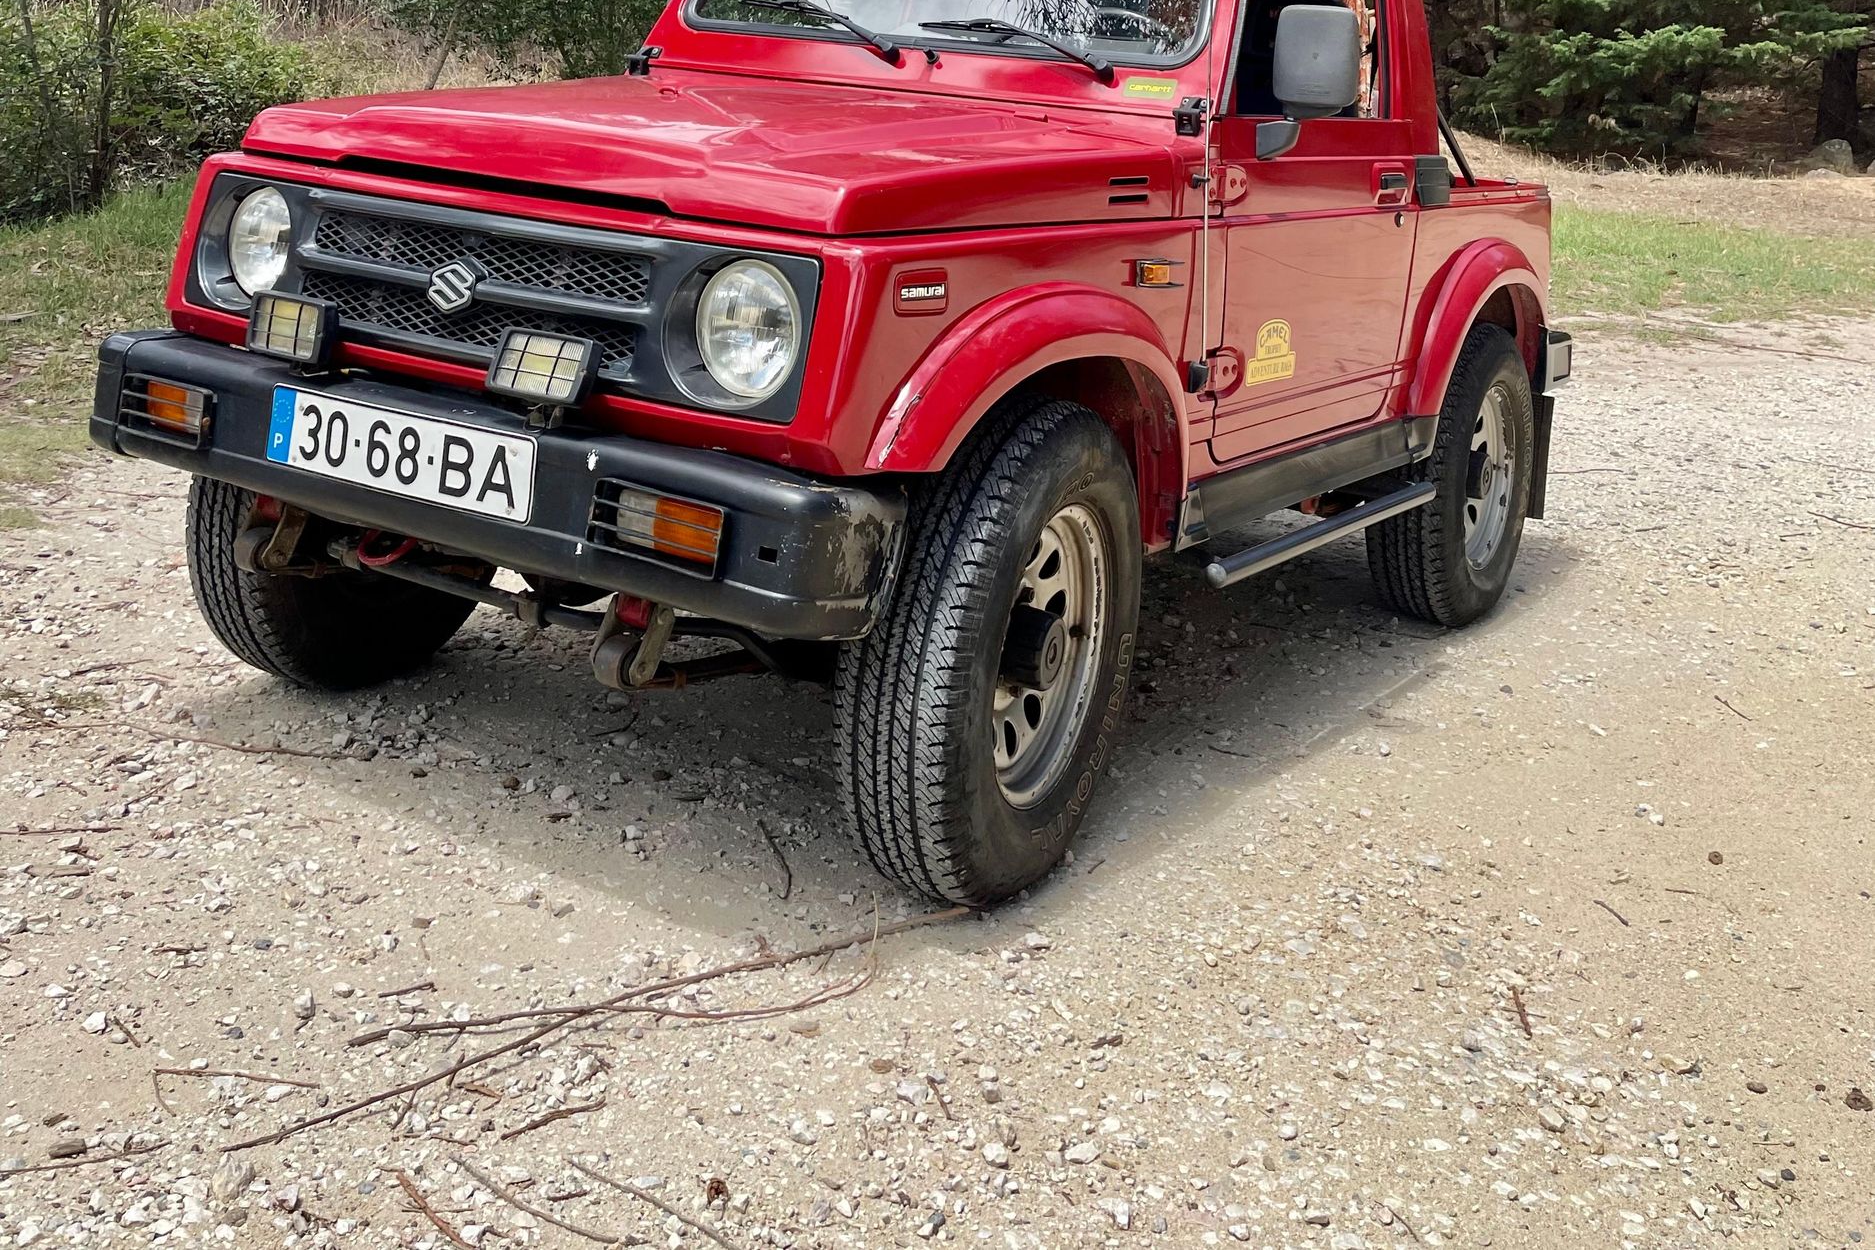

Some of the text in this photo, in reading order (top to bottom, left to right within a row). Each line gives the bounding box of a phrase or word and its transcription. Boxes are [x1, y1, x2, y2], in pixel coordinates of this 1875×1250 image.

[1129, 84, 1171, 92] carhartt
[900, 283, 945, 299] samurai
[1260, 325, 1288, 348] CAMEL
[273, 432, 284, 449] P
[1031, 633, 1133, 851] UNIROYAL
